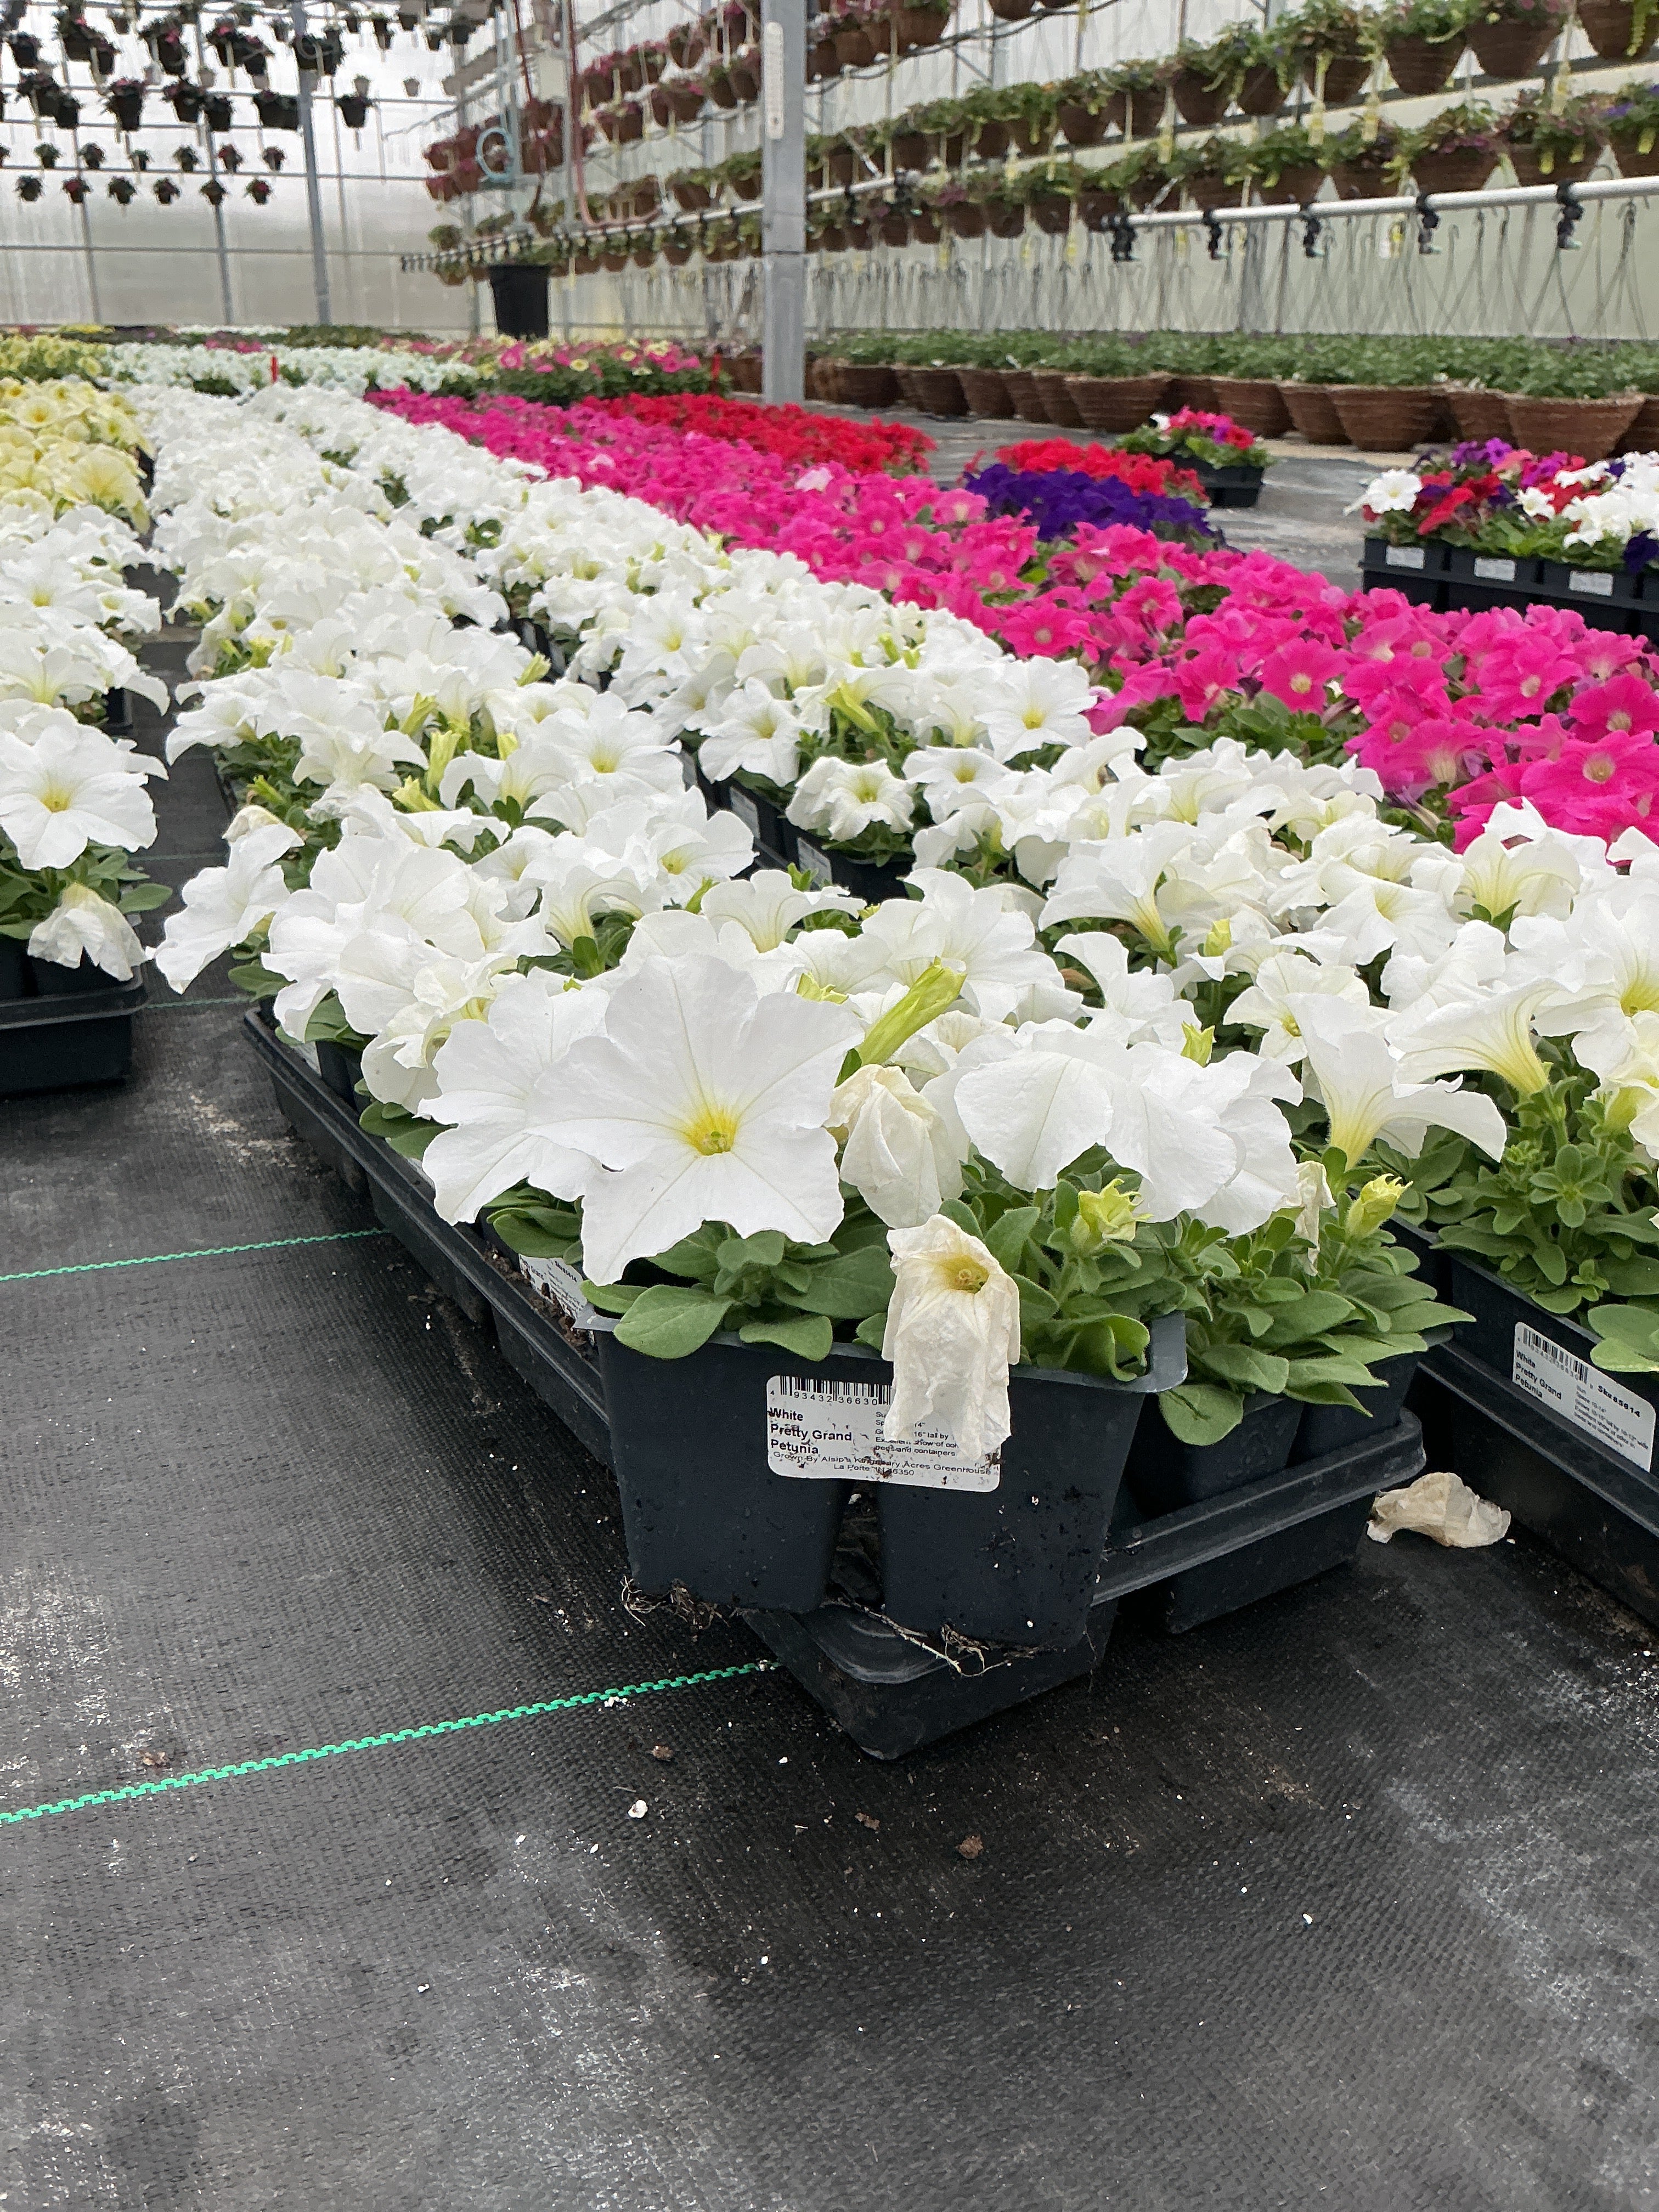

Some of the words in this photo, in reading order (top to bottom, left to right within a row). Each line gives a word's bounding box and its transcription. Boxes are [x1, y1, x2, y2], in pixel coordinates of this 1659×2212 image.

[1516, 1350, 1536, 1368] White
[1515, 1373, 1542, 1398] Petunia
[1516, 1362, 1537, 1383] Pretty
[1539, 1378, 1562, 1400] Grand
[794, 1391, 832, 1402] 93432
[838, 1396, 877, 1406] 36630
[769, 1407, 804, 1421] White
[770, 1423, 808, 1441] Pretty
[812, 1430, 852, 1441] Grand
[771, 1439, 819, 1454] Petunia
[773, 1451, 803, 1462] Grown
[904, 1460, 930, 1469] Acres
[933, 1464, 991, 1475] Greenhouse
